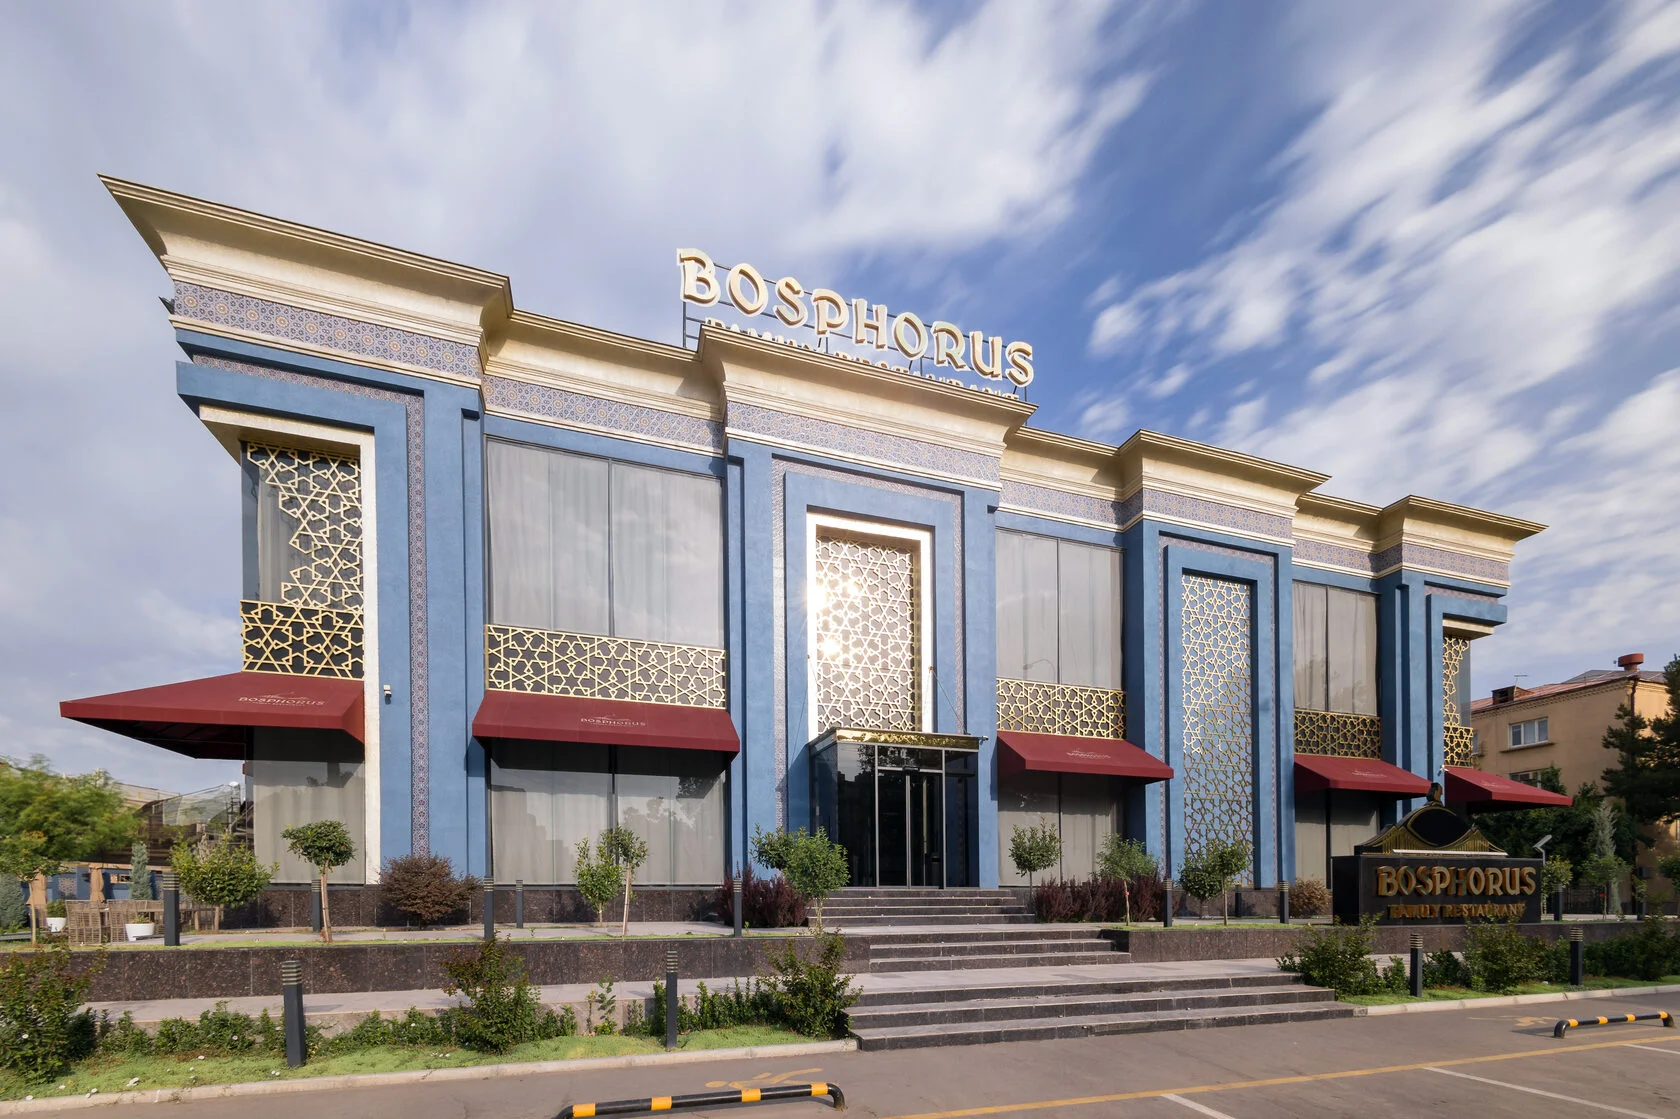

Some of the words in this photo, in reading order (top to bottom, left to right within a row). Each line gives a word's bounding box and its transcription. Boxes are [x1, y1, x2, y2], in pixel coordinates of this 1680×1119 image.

[677, 248, 1034, 388] BOSPHORUS
[1377, 865, 1537, 896] BOSPHORUS
[1388, 904, 1441, 918] FAMILY
[1443, 903, 1526, 918] RESTAURANT
